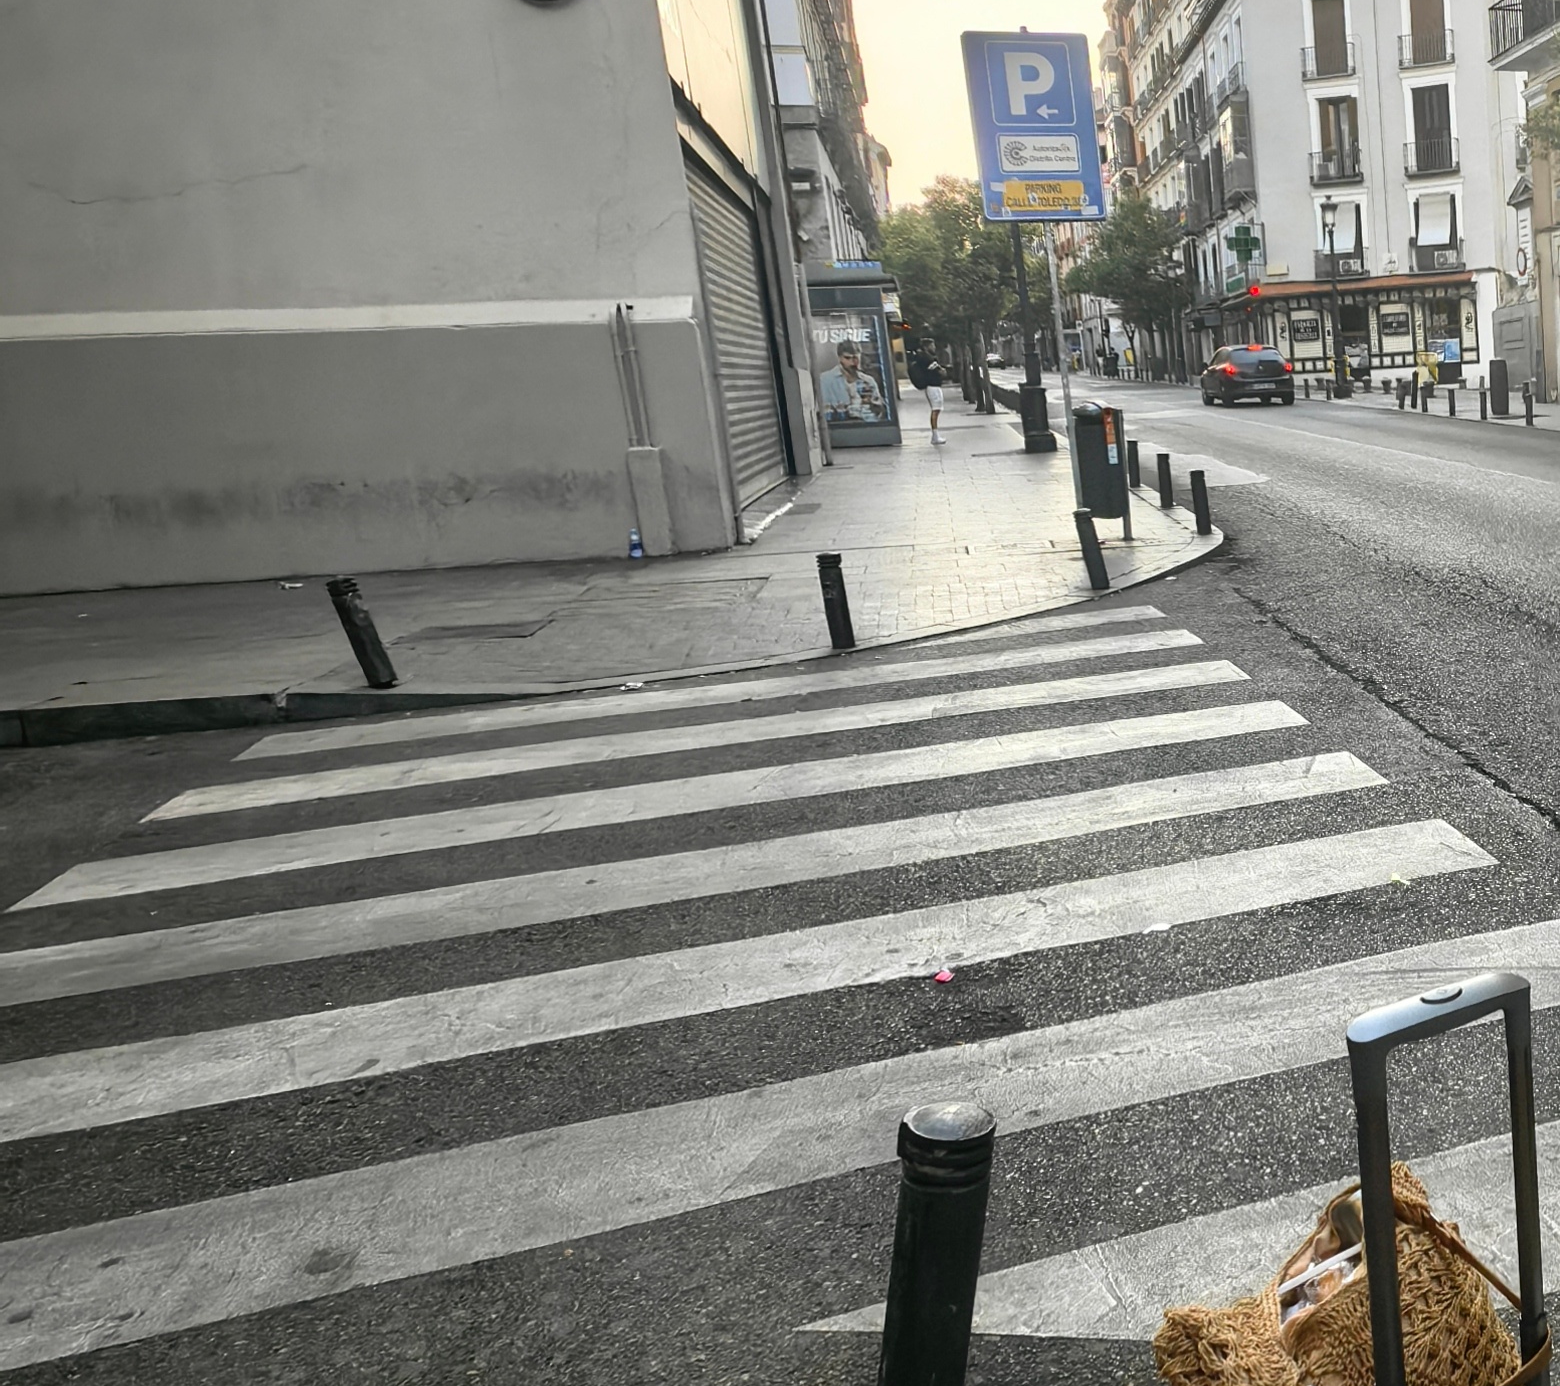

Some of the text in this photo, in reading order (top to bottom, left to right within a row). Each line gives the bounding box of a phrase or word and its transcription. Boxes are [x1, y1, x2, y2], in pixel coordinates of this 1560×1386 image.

[1003, 51, 1055, 116] P
[1025, 183, 1062, 194] PARKING
[829, 328, 872, 344] SIGUE
